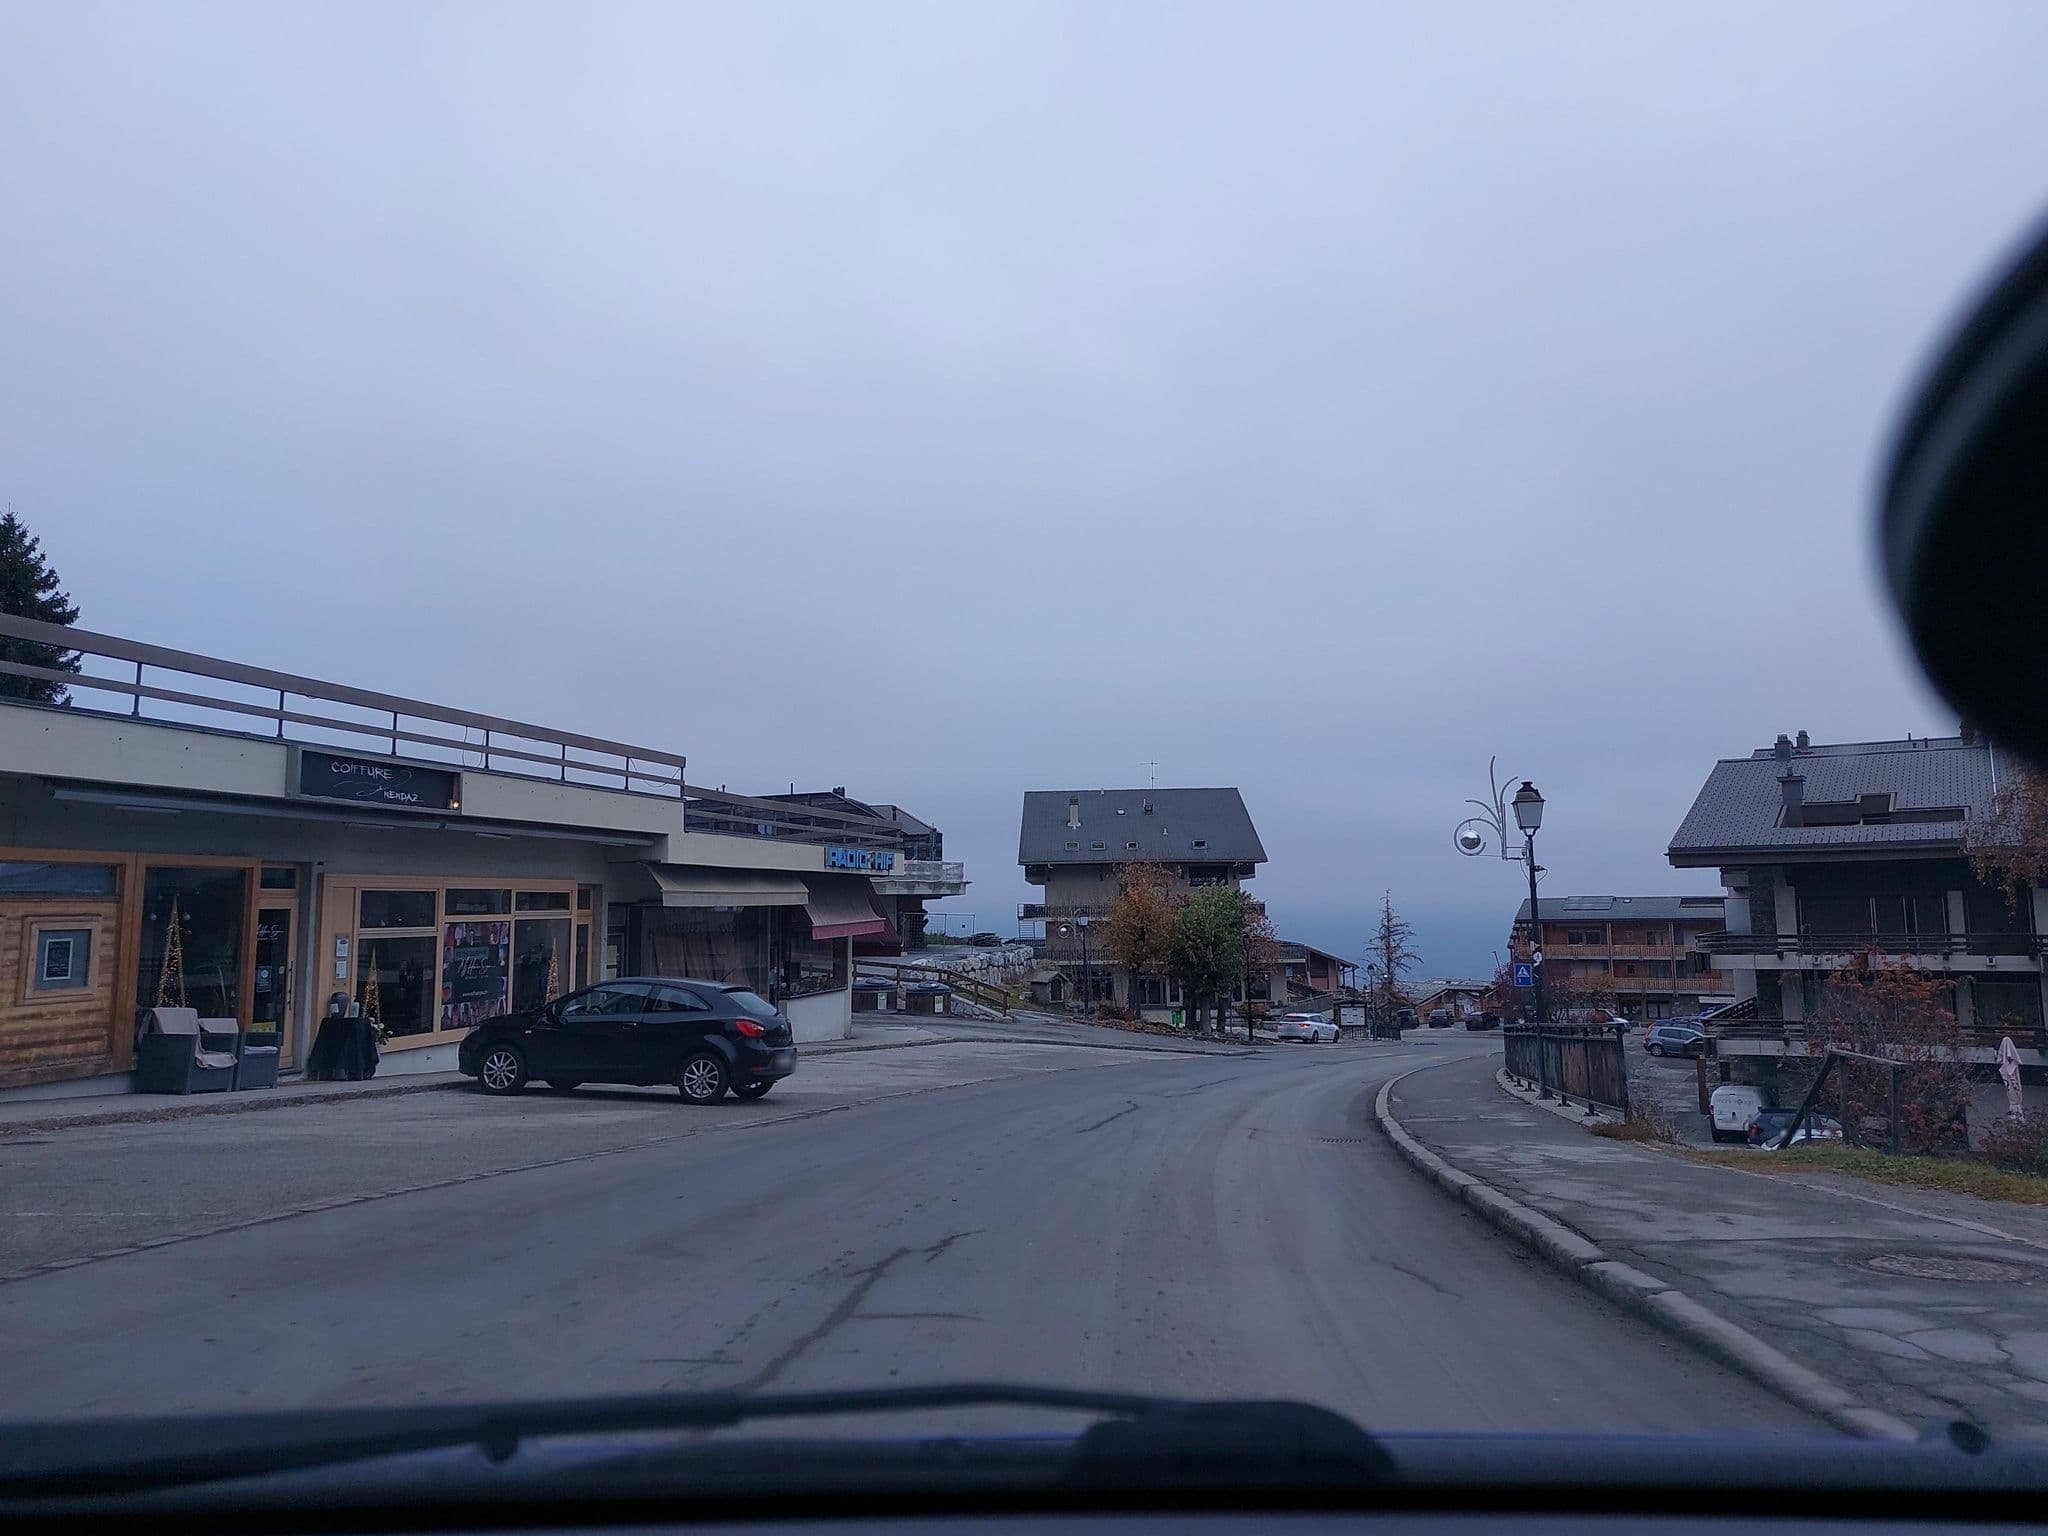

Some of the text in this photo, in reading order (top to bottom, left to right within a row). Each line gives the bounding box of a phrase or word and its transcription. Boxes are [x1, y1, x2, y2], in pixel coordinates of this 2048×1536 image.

[331, 761, 394, 780] COIFFURE
[383, 790, 421, 803] NENDAZ
[829, 847, 868, 869] RADIO
